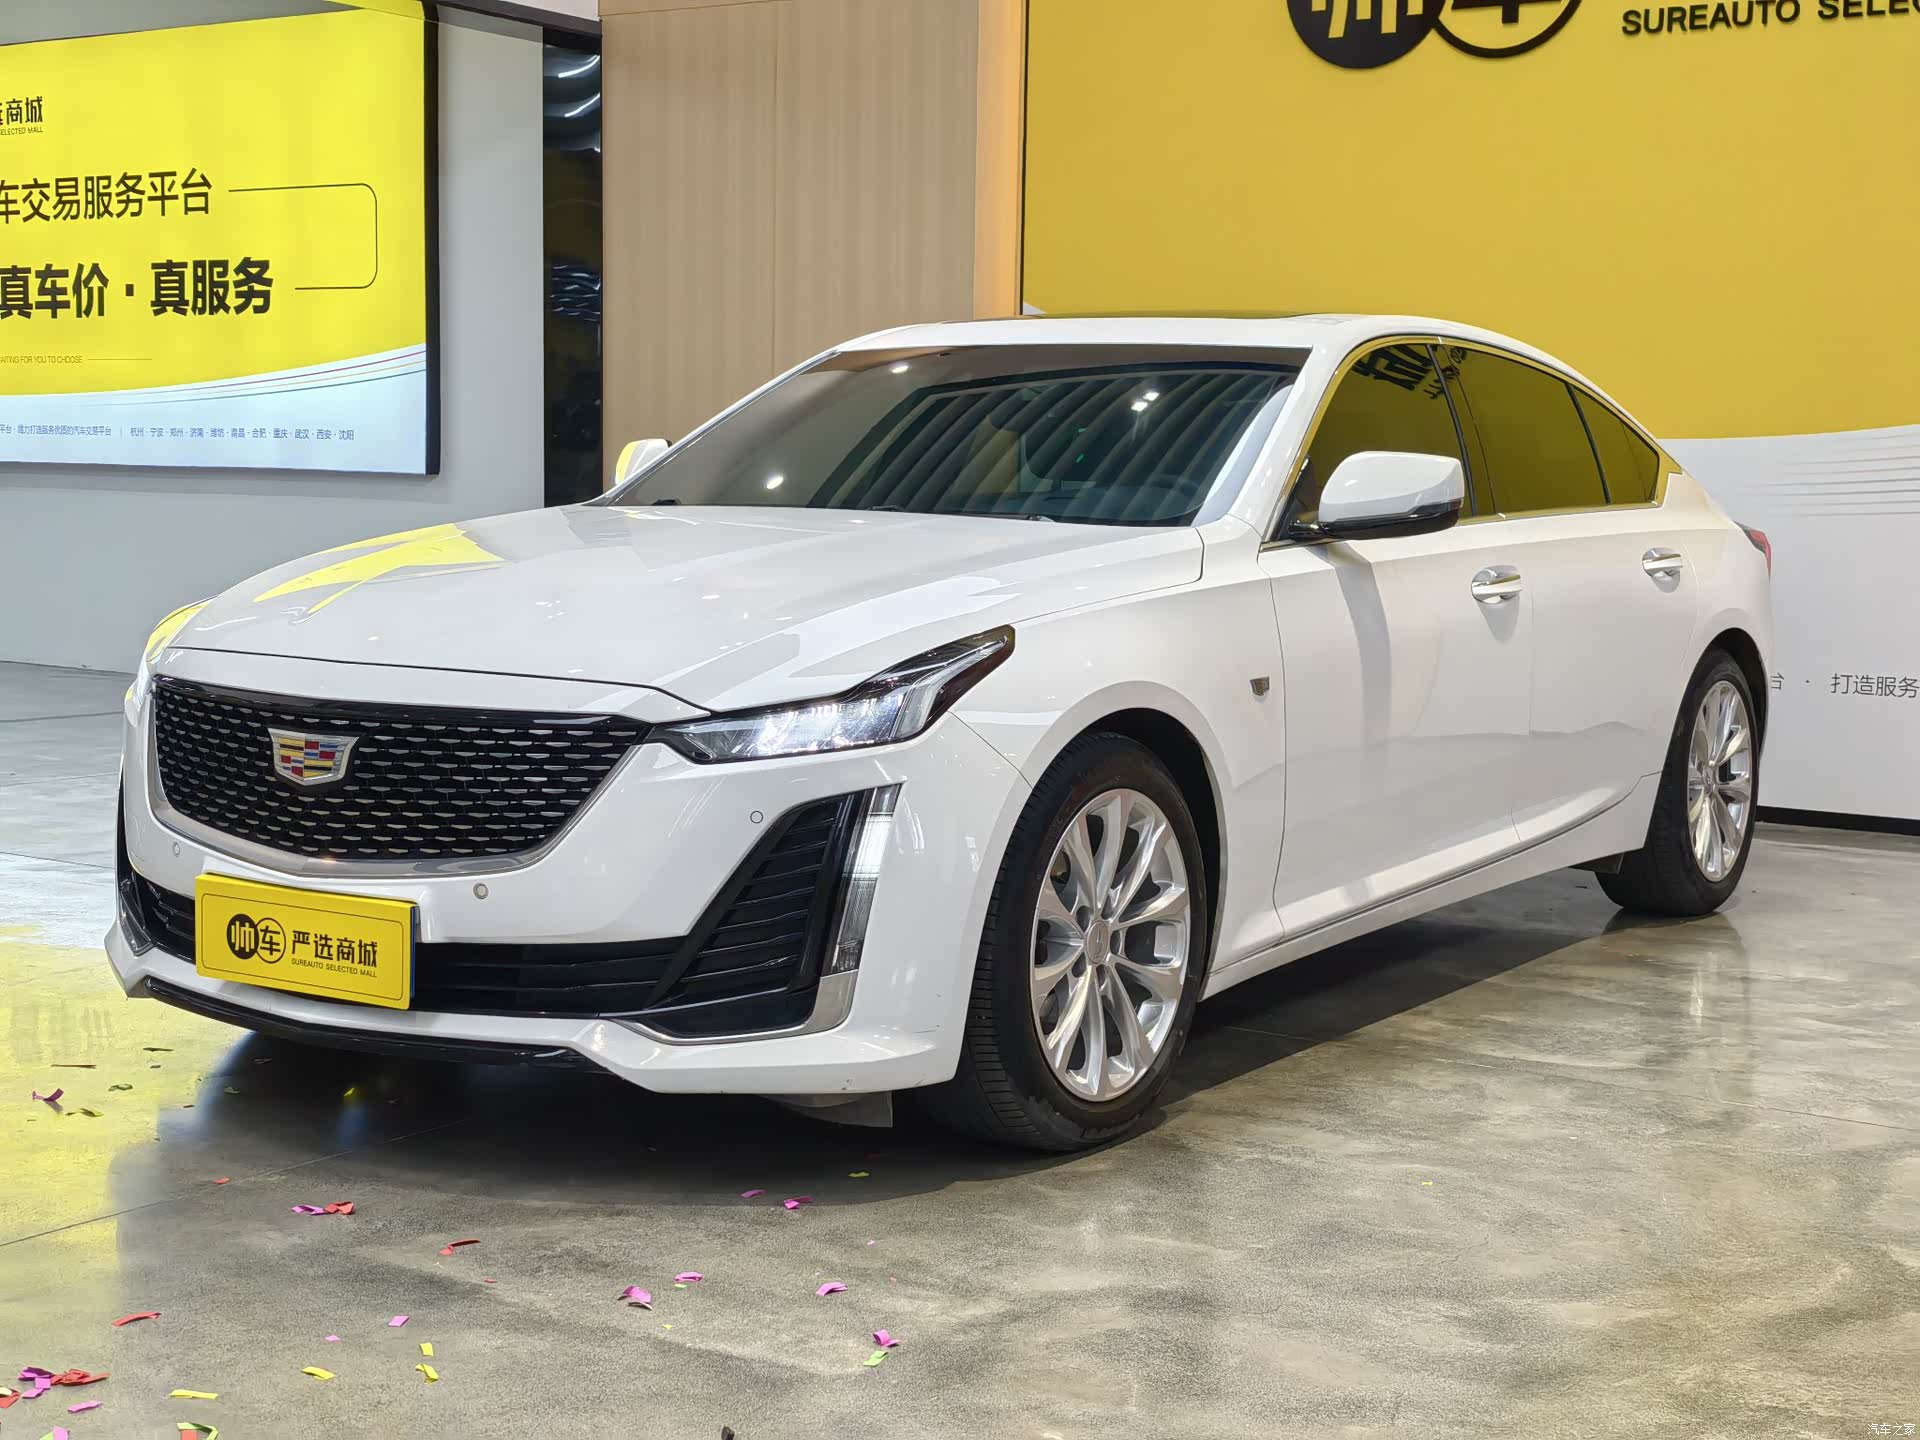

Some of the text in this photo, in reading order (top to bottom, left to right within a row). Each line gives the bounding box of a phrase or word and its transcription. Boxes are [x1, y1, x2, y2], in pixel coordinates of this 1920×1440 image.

[1621, 0, 1920, 36] SUREAUTO SELE
[0, 96, 43, 126] 商城
[0, 126, 44, 136] ELECTED MALL
[0, 167, 213, 224] 车交易服务平台
[0, 355, 20, 364] AITING
[20, 355, 33, 364] FOR
[34, 355, 47, 364] YOU
[57, 355, 83, 364] CHOOSE
[291, 929, 378, 968] 严选商城
[291, 957, 378, 978] SUREAUTO SELECTED MALL
